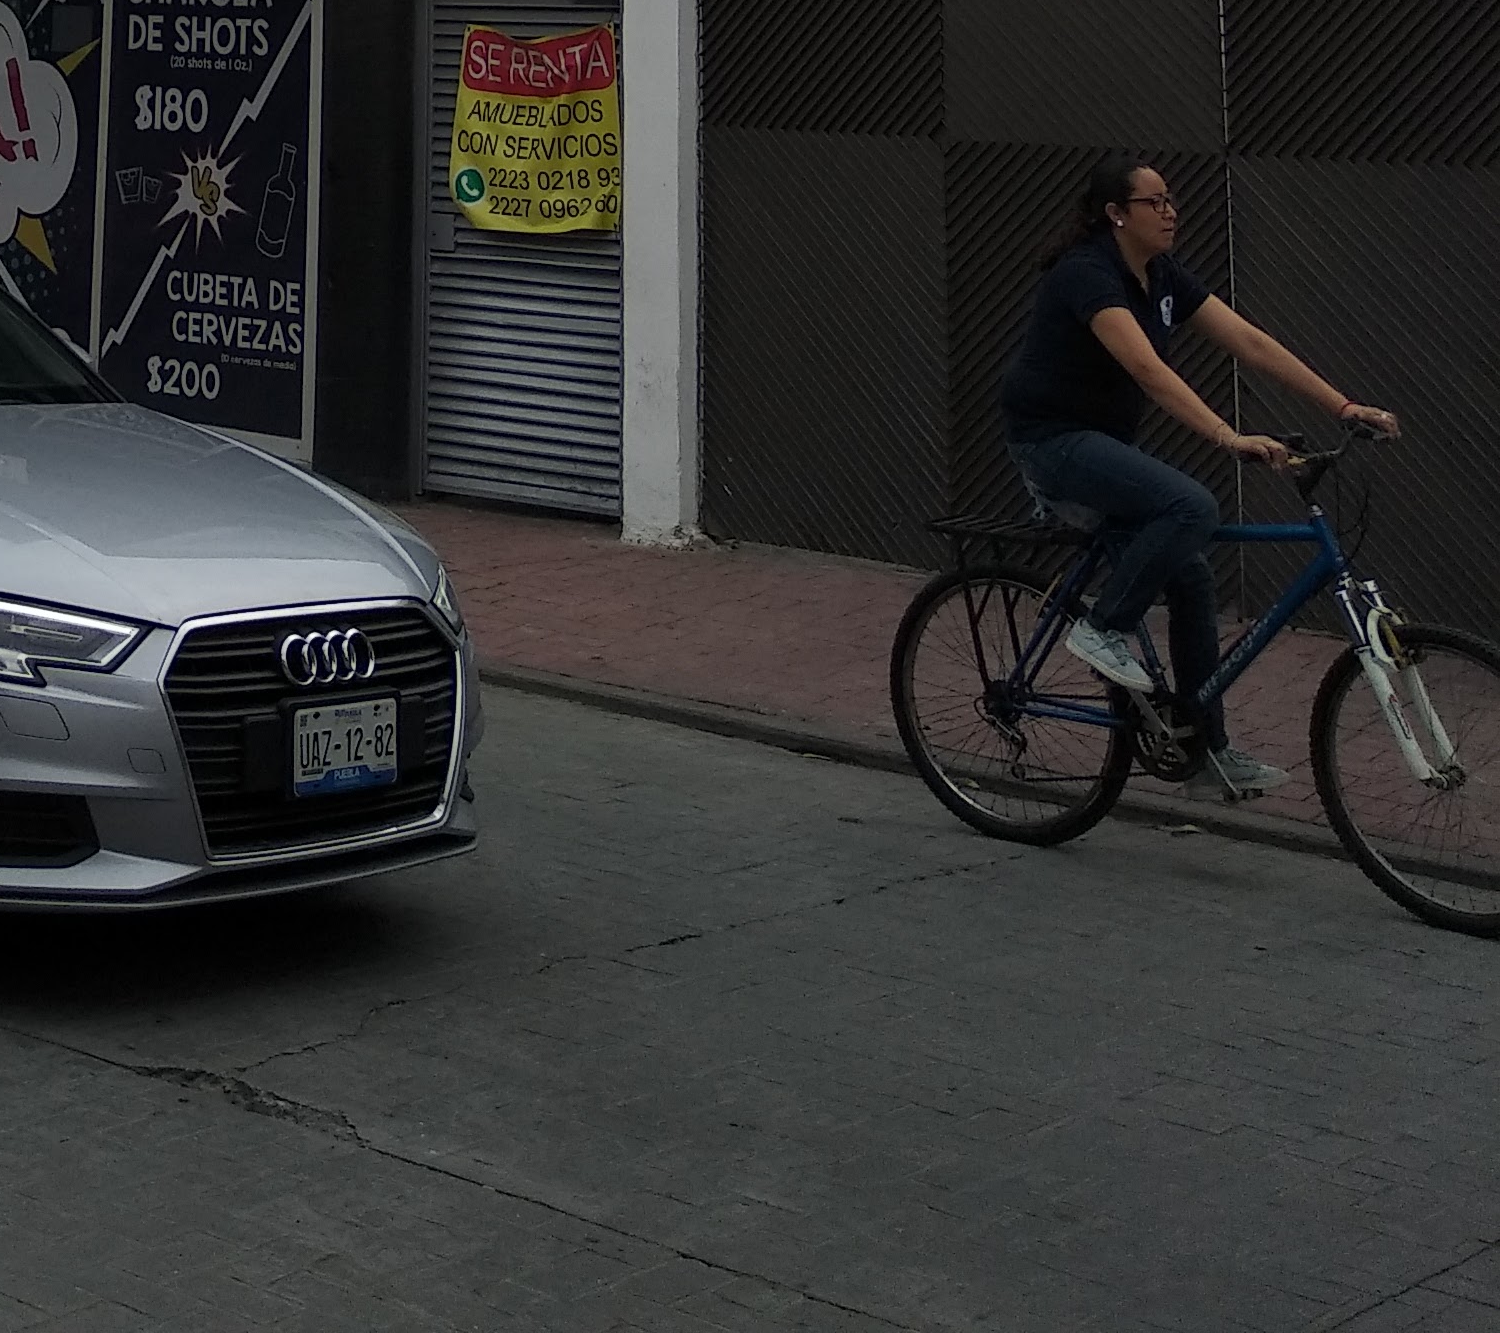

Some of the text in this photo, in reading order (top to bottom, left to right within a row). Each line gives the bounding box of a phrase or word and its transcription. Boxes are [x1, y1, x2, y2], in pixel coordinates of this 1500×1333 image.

[127, 13, 270, 56] DE SHOTS
[187, 57, 212, 70] shots
[214, 58, 227, 70] de
[467, 39, 610, 88] SE RENTA
[134, 84, 209, 133] $180
[467, 99, 604, 128] AMUEBLADOS
[457, 129, 618, 161] CON SERVICIOS
[190, 165, 221, 216] VS
[488, 166, 621, 191] 2223 0218 93
[488, 195, 532, 218] 2227
[538, 197, 592, 219] 0962
[166, 269, 301, 314] CUBETA DE
[171, 310, 302, 354] CERVEZAS
[146, 354, 221, 401] $200
[299, 723, 394, 769] UAZ-12-82
